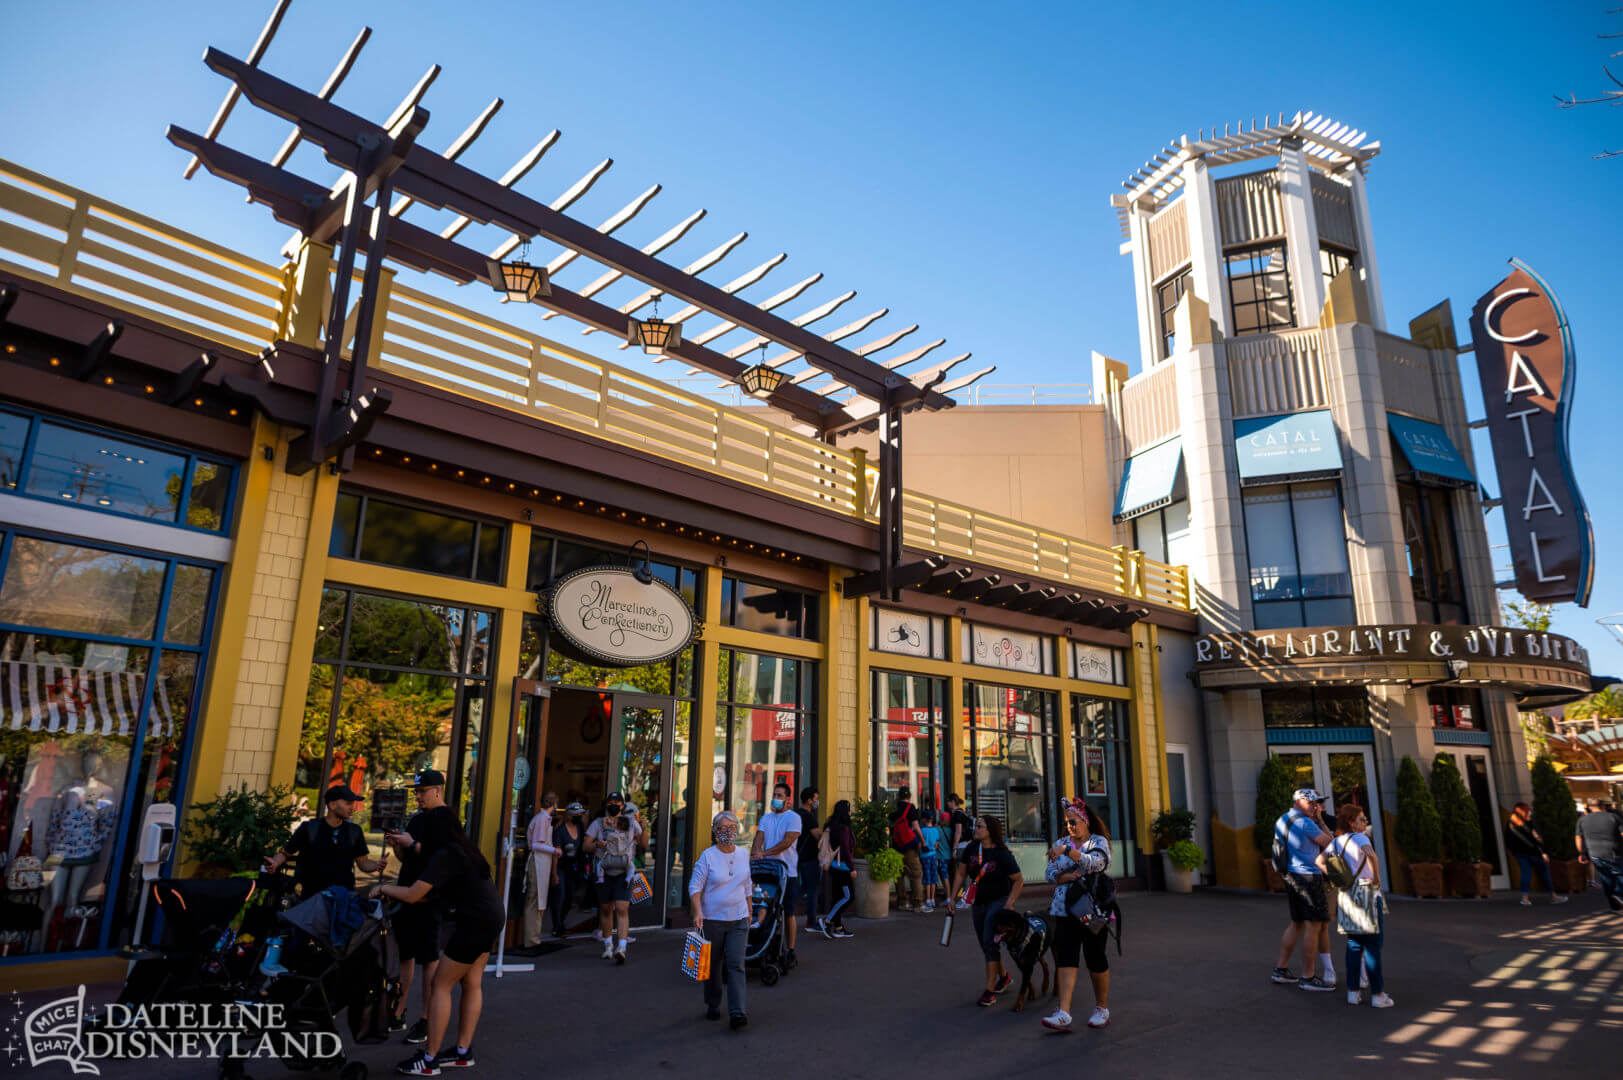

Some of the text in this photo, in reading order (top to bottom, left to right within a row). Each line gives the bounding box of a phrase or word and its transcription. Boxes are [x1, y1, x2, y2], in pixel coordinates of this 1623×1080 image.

[1250, 429, 1321, 447] CATAL
[1485, 288, 1567, 583] CATAL
[581, 580, 658, 616] Marceline's
[578, 605, 673, 646] Confectionery
[1196, 628, 1411, 662] RESTAURANT
[1430, 631, 1453, 656] &
[1464, 626, 1515, 657] UVA
